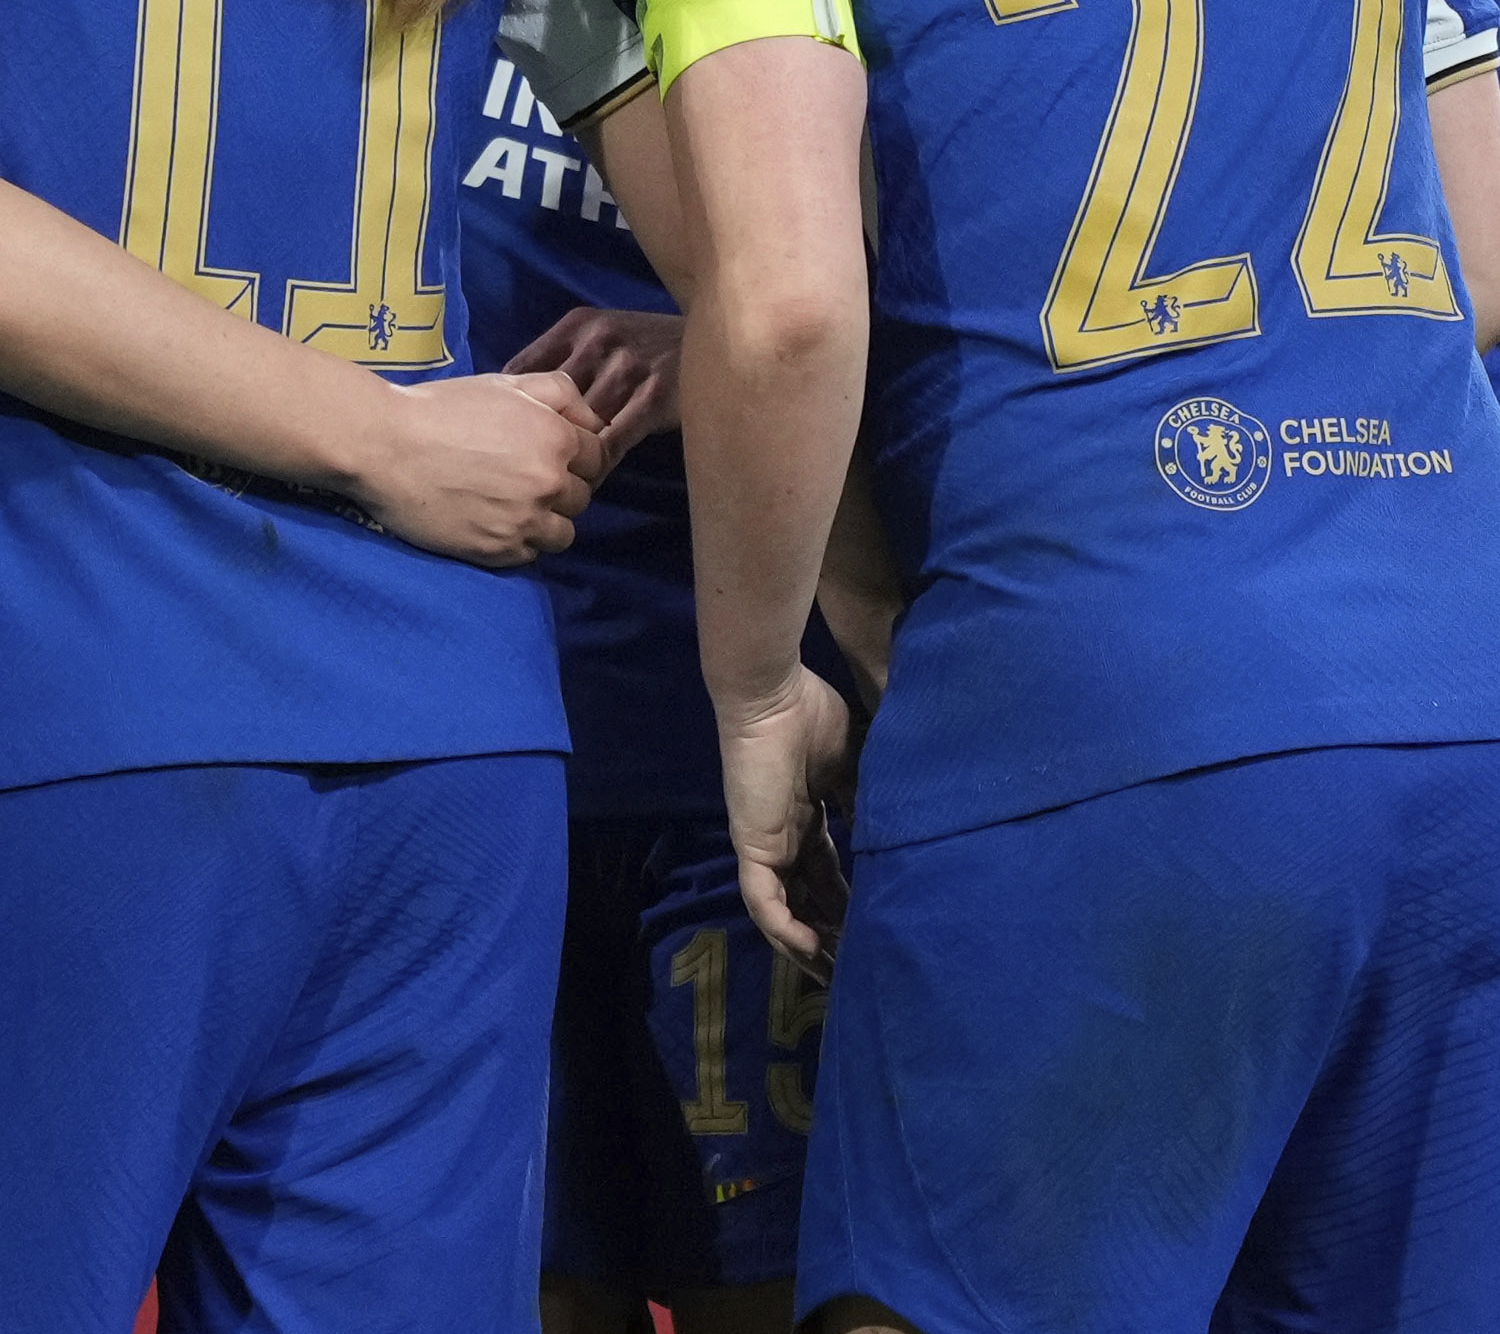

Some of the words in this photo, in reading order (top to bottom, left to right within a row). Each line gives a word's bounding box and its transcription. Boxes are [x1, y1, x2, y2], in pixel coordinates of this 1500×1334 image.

[1168, 401, 1241, 428] CHELSEA
[1280, 417, 1391, 446] CHELSEA
[1284, 449, 1453, 479] FOUNDATION
[1184, 486, 1235, 505] FOOTBALL
[1237, 481, 1258, 502] CLUB
[671, 928, 829, 1135] 15
